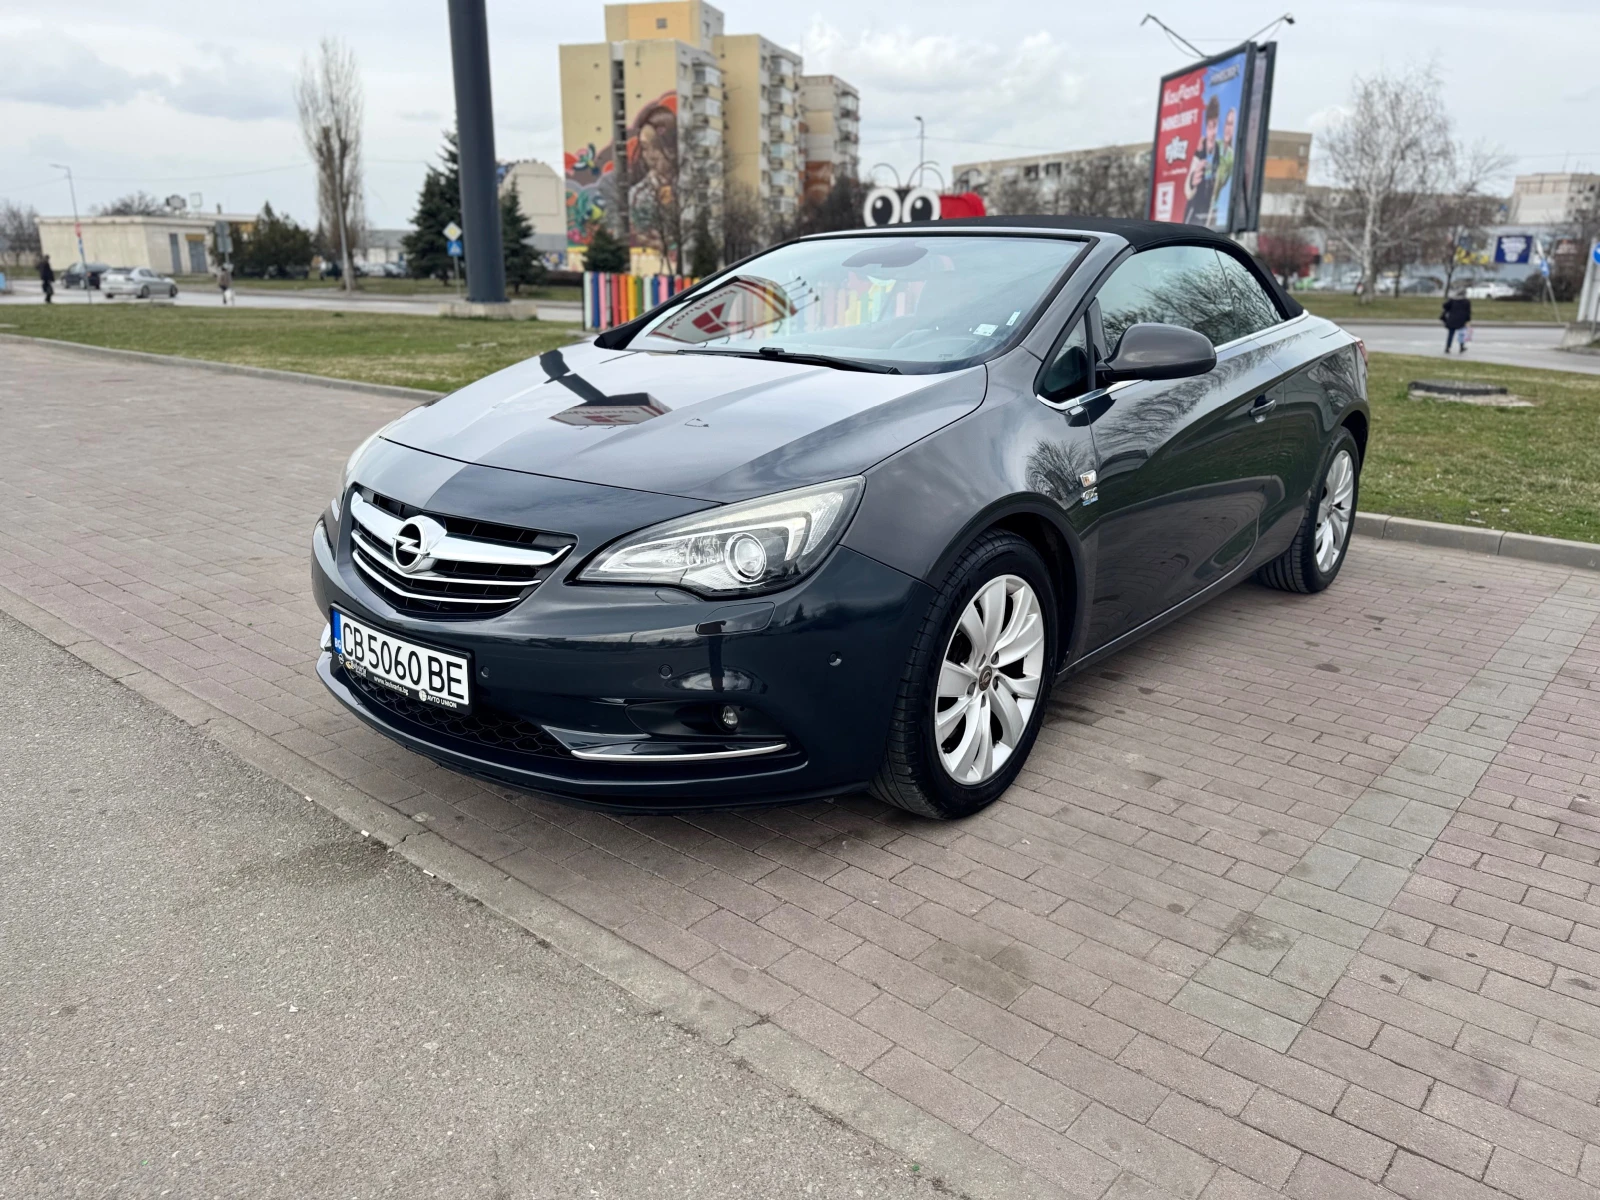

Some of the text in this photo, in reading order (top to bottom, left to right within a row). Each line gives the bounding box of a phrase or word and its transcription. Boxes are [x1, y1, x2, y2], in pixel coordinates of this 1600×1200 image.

[334, 637, 342, 650] BG
[343, 622, 365, 663] CB
[368, 633, 422, 686] 5060
[428, 655, 464, 700] BE
[440, 698, 457, 709] UNION
